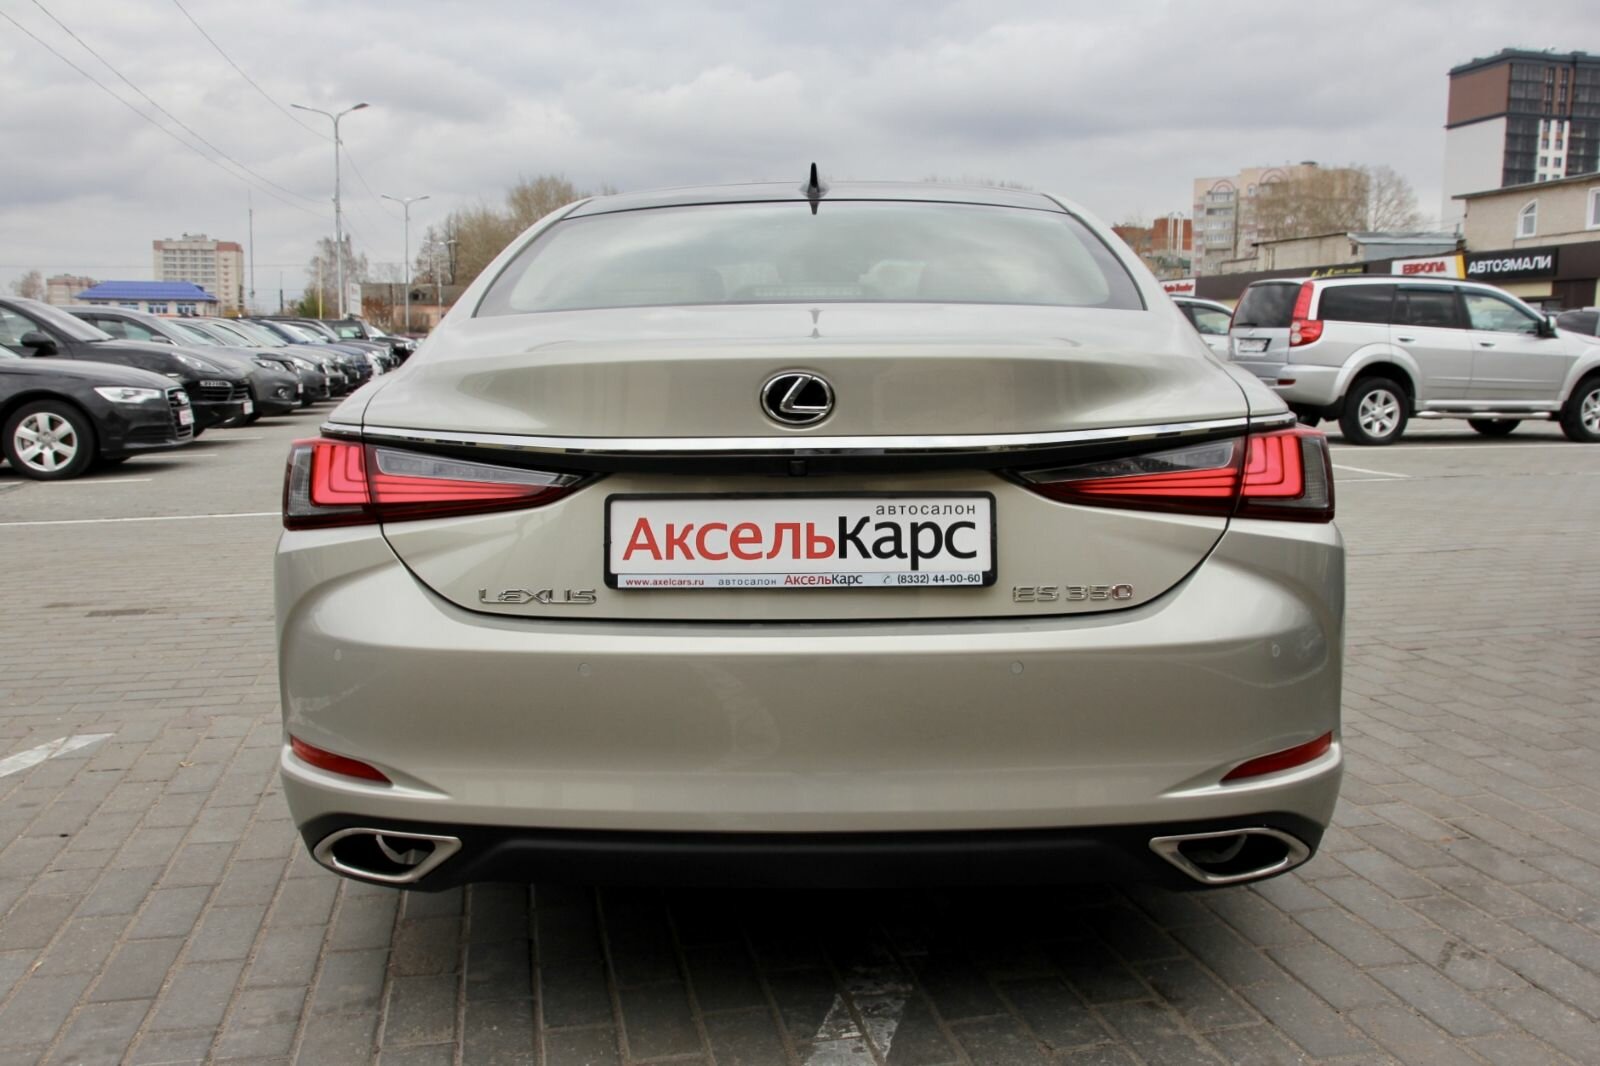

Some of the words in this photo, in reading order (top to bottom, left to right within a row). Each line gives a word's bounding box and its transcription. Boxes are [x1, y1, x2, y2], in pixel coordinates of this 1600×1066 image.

[1402, 260, 1447, 275] ЕВРОПА
[1468, 255, 1552, 274] АВТОЭМАЛИ
[876, 502, 976, 516] автосалон
[622, 515, 979, 571] АксельКарс
[625, 578, 705, 586] www.axelcars.ru
[717, 578, 777, 586] автосалон
[784, 574, 864, 586] АксельКарс
[897, 574, 929, 585] (8332)
[932, 573, 981, 584] 44-00-60
[478, 588, 598, 605] LEXUS
[1012, 586, 1060, 603] ES
[1065, 583, 1133, 602] 350
